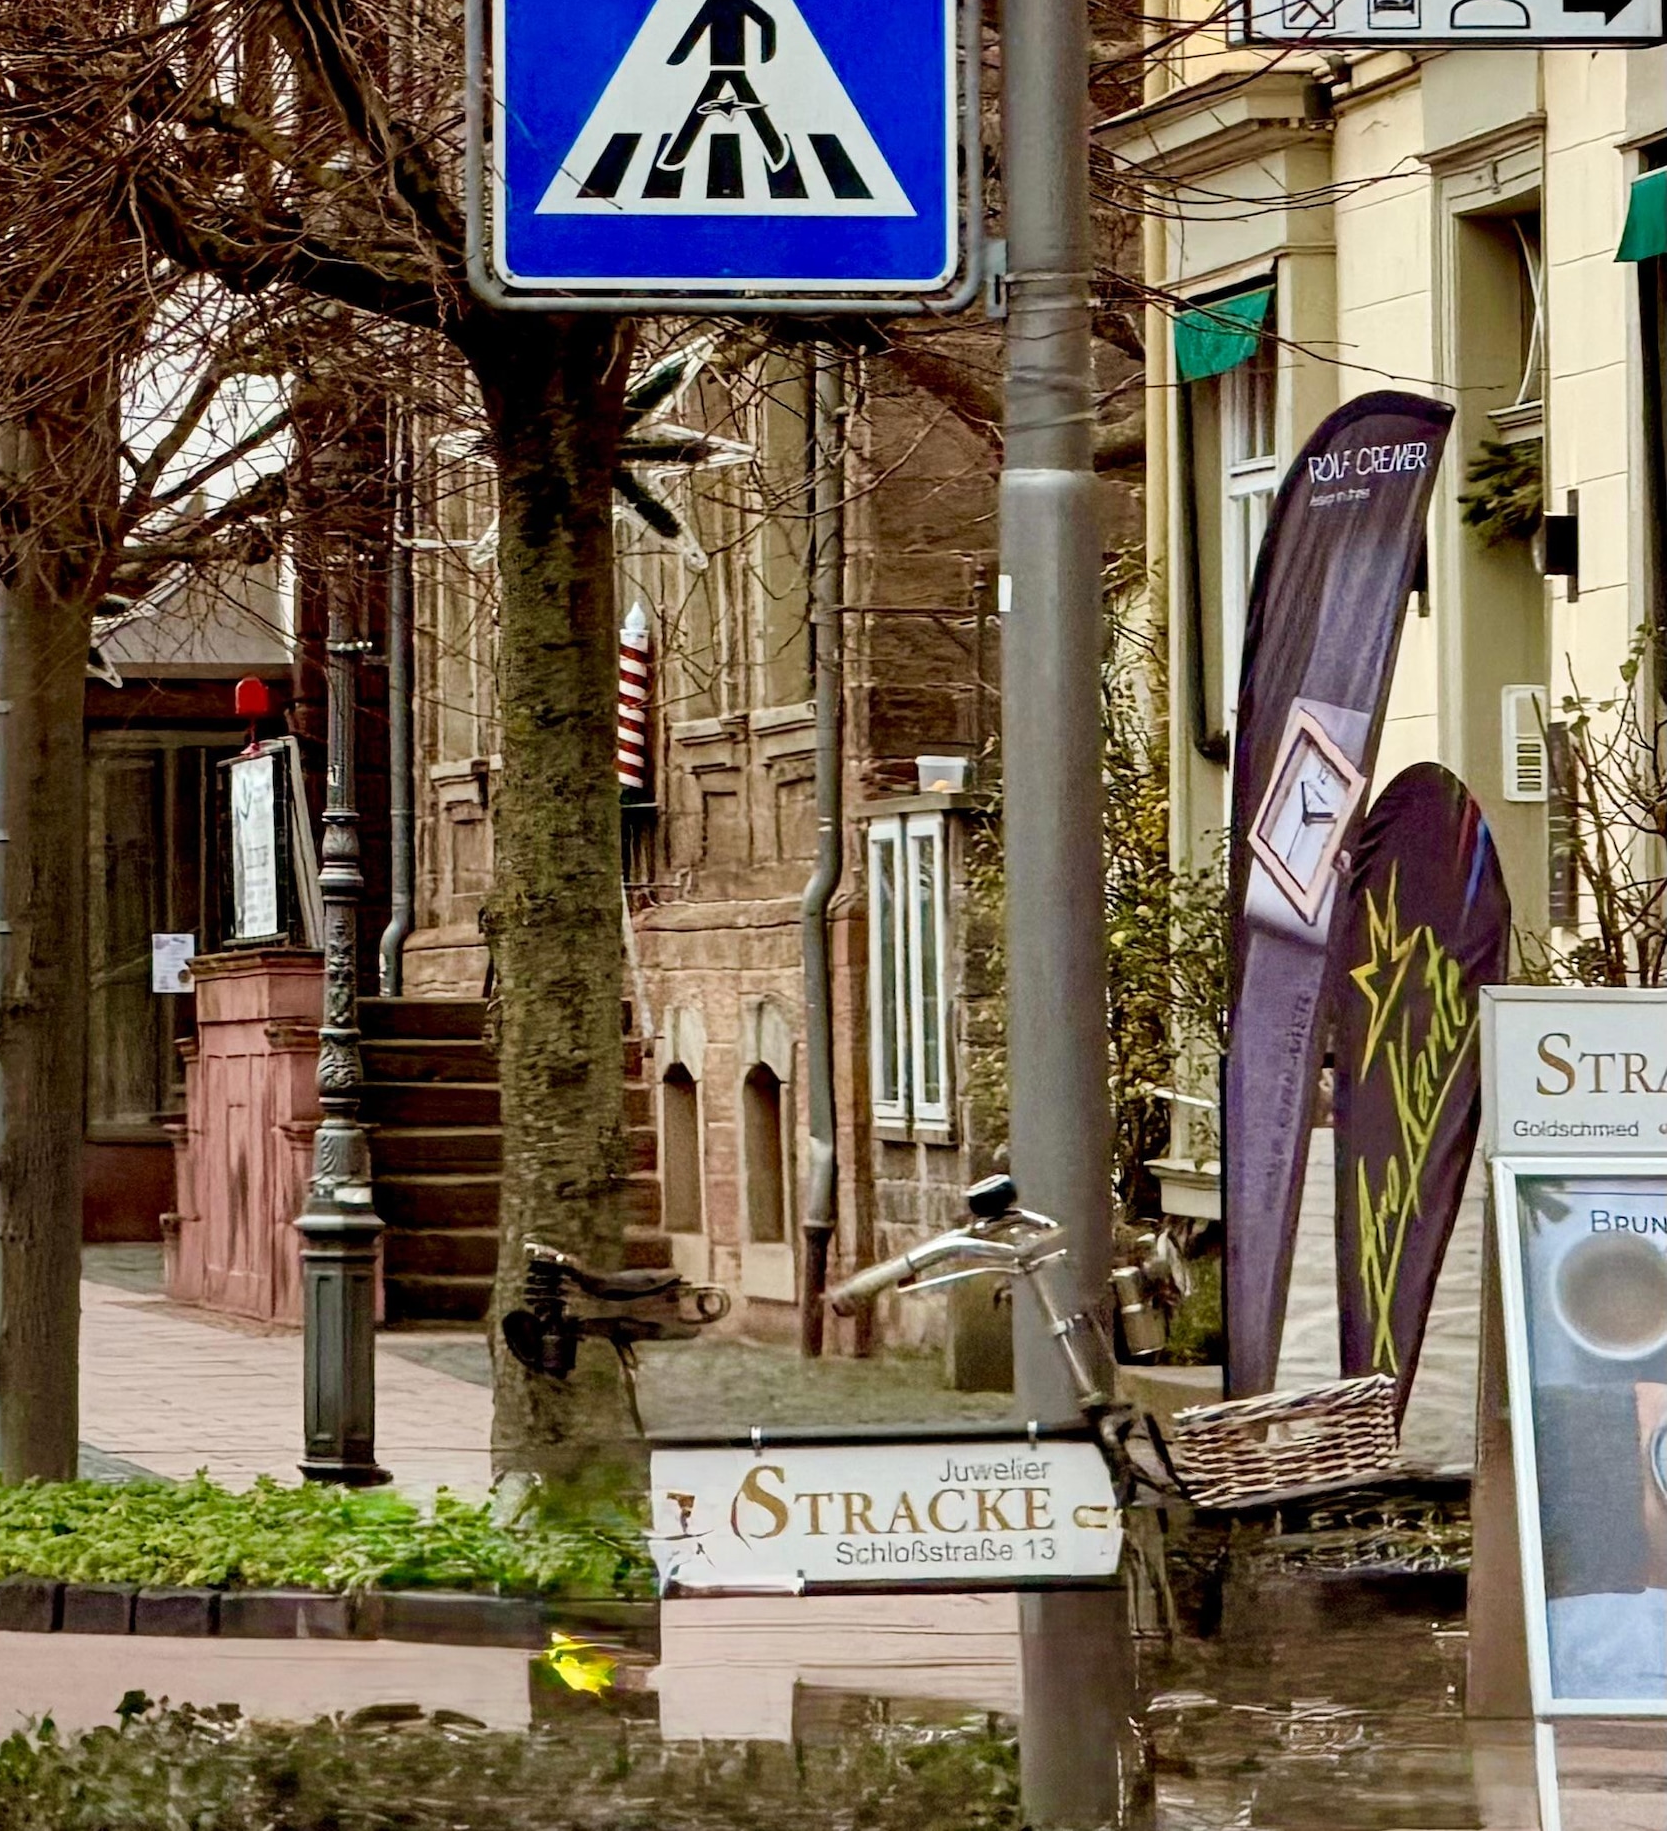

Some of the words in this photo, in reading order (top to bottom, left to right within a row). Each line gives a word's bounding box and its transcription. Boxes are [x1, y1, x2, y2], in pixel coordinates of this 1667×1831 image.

[1536, 1032, 1667, 1097] STR
[939, 1457, 1052, 1483] Juwelier
[735, 1465, 1056, 1540] STRACKE
[835, 1538, 1013, 1565] Schloßstraße
[1023, 1537, 1057, 1561] 13
